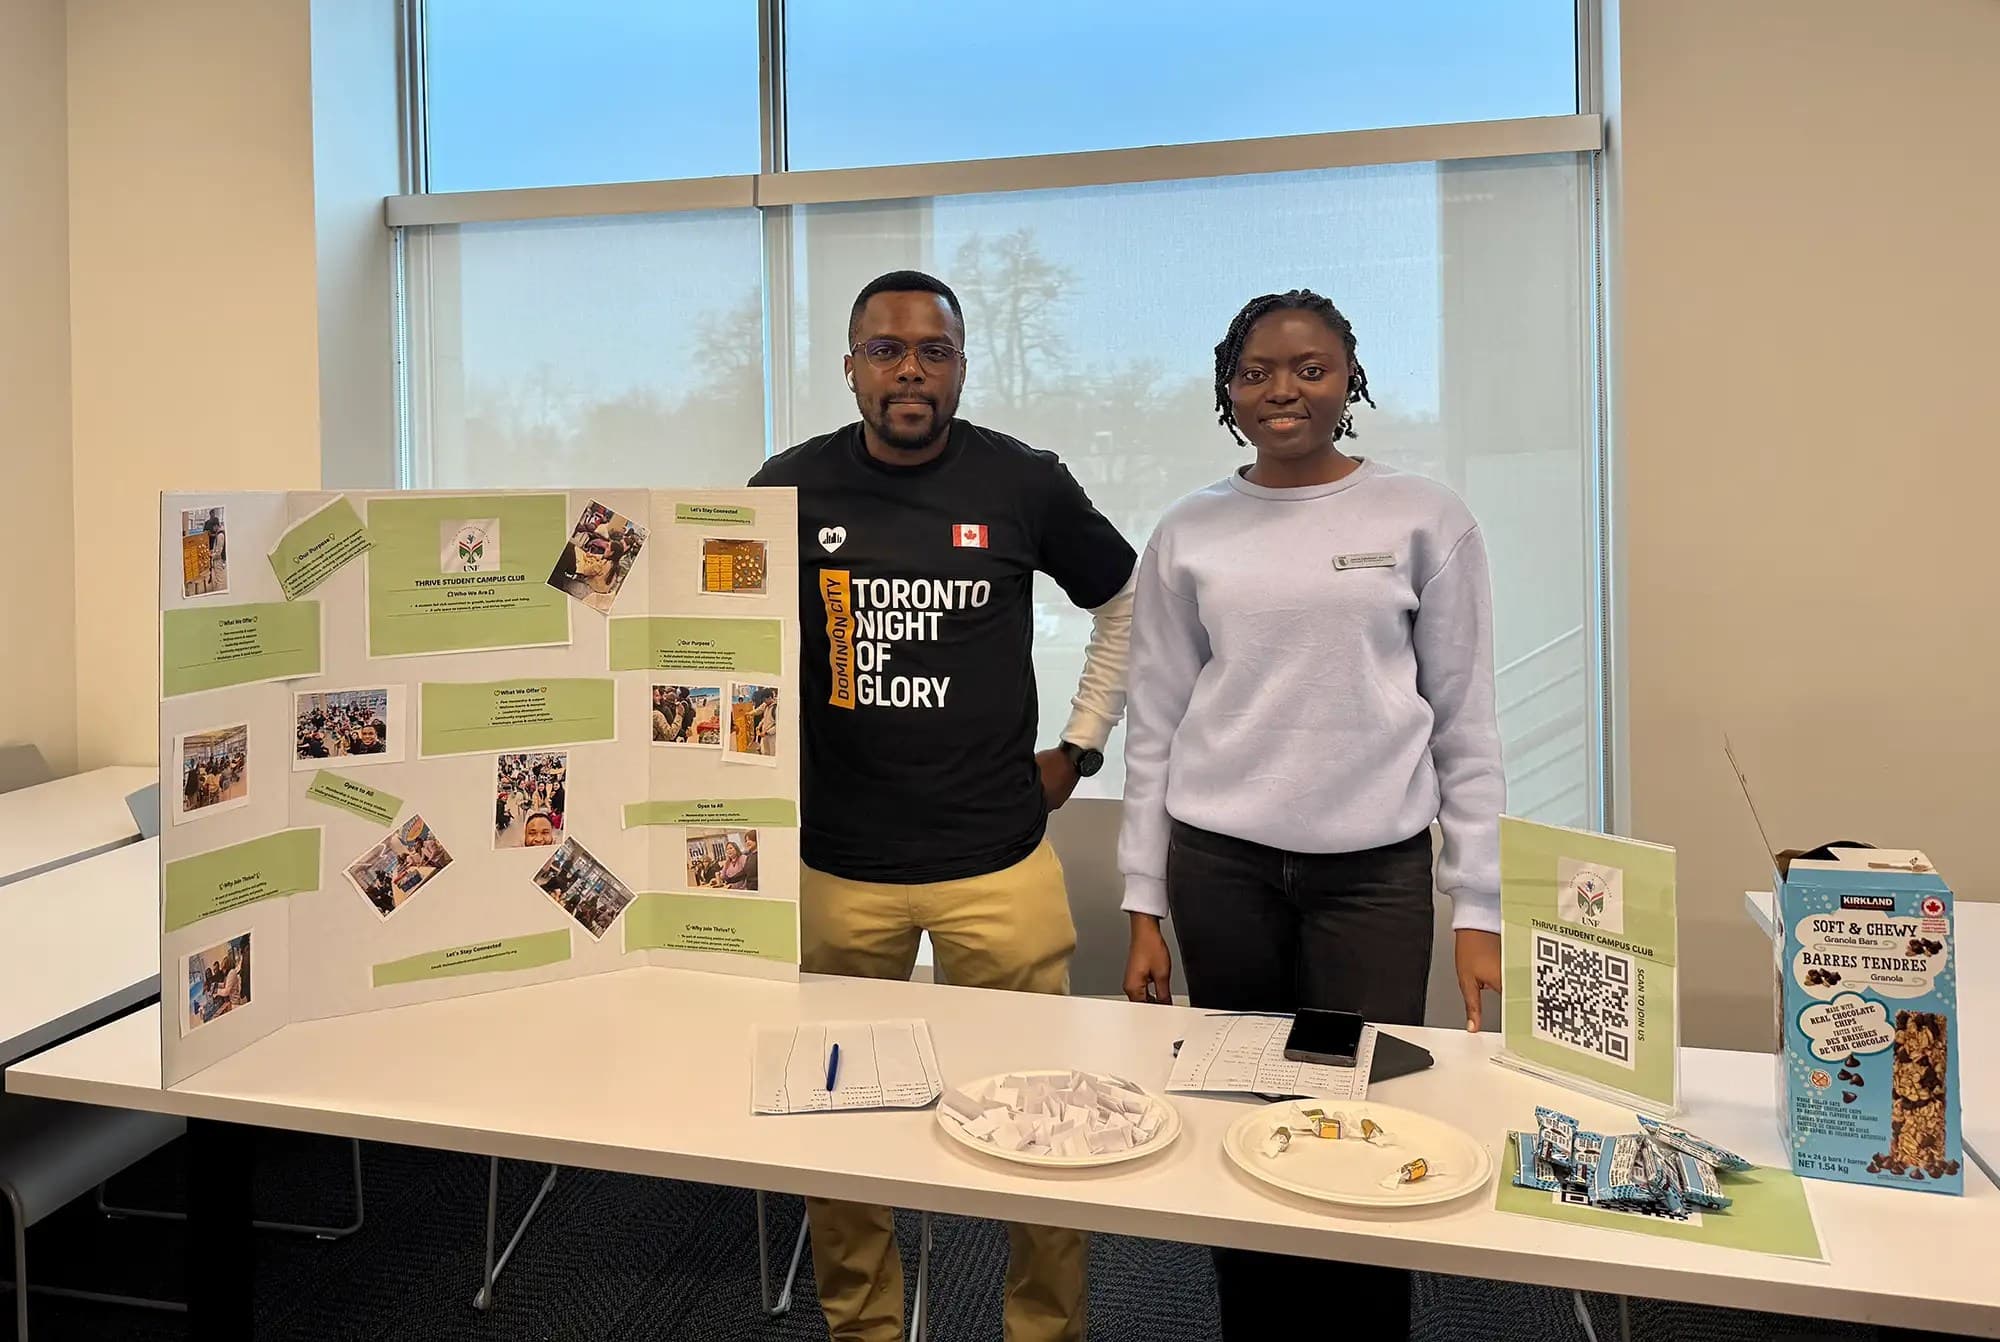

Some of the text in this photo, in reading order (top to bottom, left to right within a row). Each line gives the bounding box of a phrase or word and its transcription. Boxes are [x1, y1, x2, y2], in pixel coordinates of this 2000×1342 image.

[309, 538, 330, 554] Purpose
[415, 579, 441, 587] THRIVE
[442, 577, 475, 585] STUDENT
[476, 575, 506, 583] CAMPUS
[852, 578, 991, 610] TORONTO
[855, 610, 943, 641] NIGHT
[826, 577, 850, 701] DOMINION CITY
[856, 640, 891, 673] OF
[857, 674, 951, 709] GLORY
[344, 782, 358, 792] Open
[1843, 896, 1893, 906] KIRKLAND
[1581, 917, 1600, 928] UNF
[1813, 919, 1845, 933] SOFT
[1849, 922, 1862, 935] &
[1866, 923, 1918, 937] CHEWY
[1531, 918, 1654, 957] THRIVE STUDENT CAMPUS CLUB
[1824, 935, 1878, 946] Granola Bars
[446, 950, 459, 958] Let's
[473, 942, 501, 952] Connected
[1802, 952, 1927, 972] BARRES TENDRES
[1870, 973, 1904, 983] Granola
[1637, 968, 1645, 1042] SCAN TO JOIN US
[1810, 1005, 1876, 1025] REAL CHOCOLATE
[1834, 1018, 1857, 1028] CHIPS
[1819, 1034, 1890, 1055] DE VRAI CHOCOLAT
[1825, 1029, 1878, 1046] DES BRISURES
[1798, 1159, 1849, 1175] NET 1.54 kg
